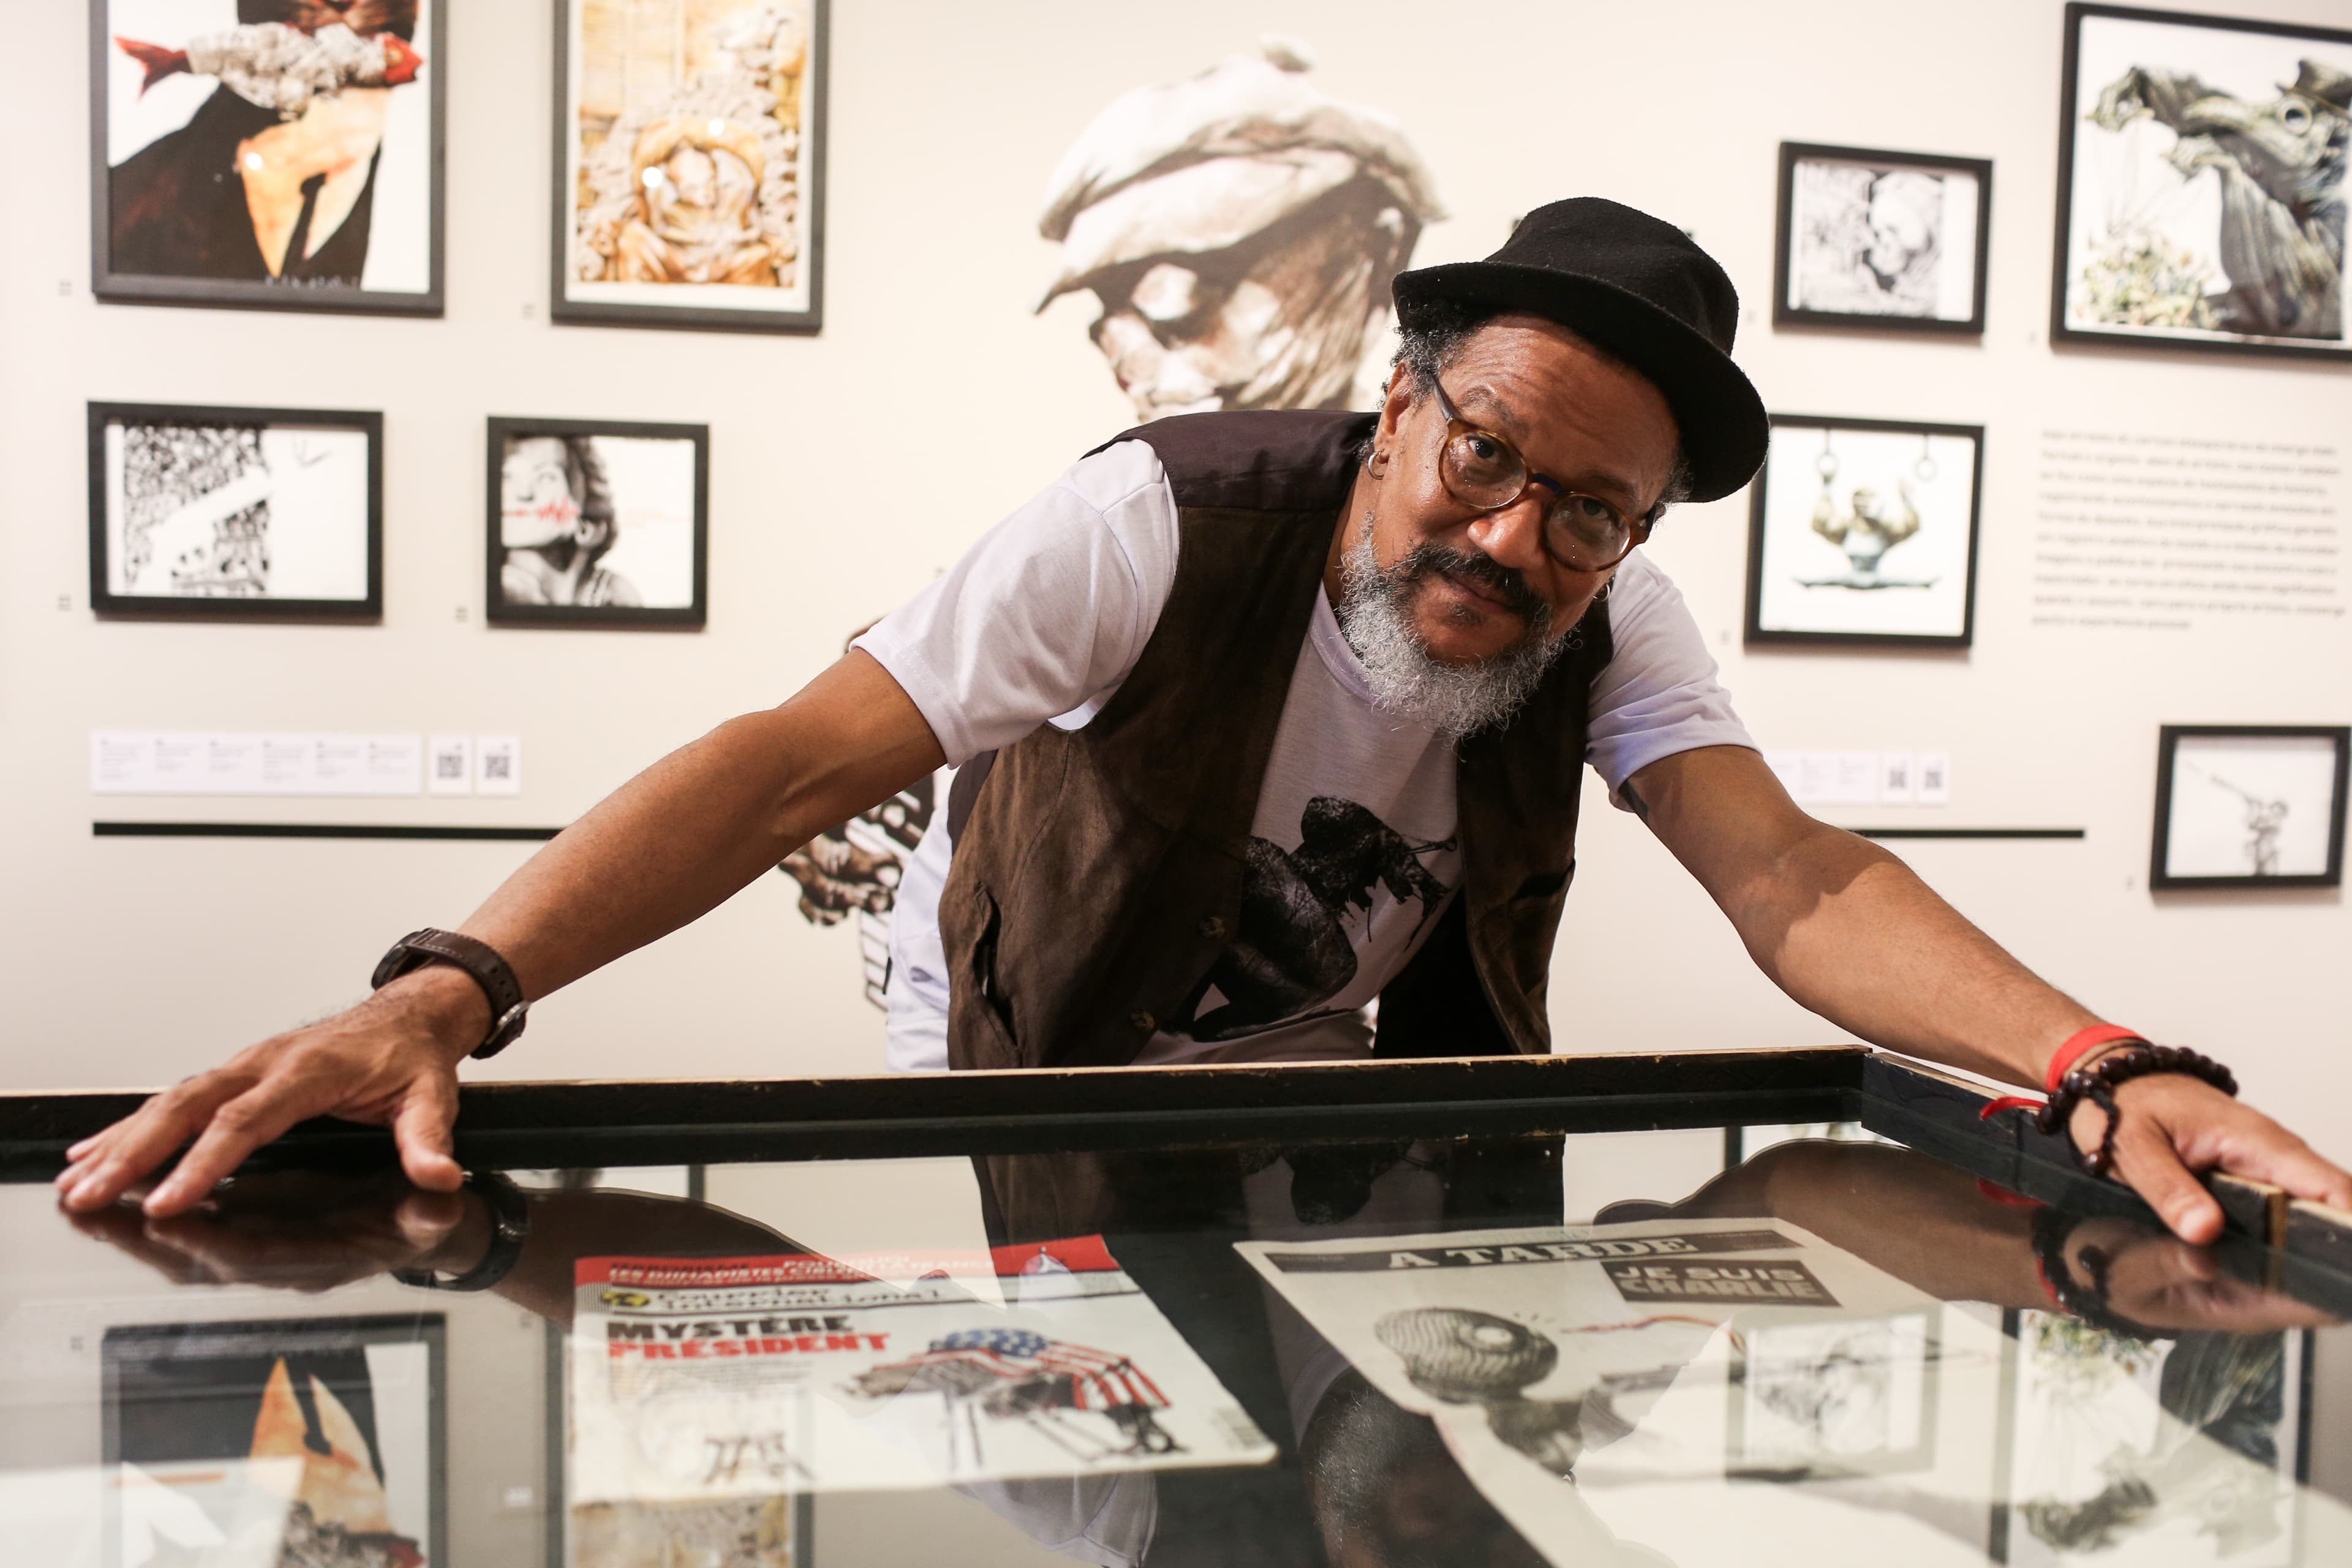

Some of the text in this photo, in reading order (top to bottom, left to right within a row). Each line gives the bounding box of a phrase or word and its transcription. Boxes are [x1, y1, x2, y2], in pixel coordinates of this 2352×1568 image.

[1389, 1237, 1698, 1269] A TARDE
[609, 1268, 643, 1279] LES
[1613, 1266, 1804, 1281] JE SUIS
[1619, 1279, 1823, 1298] CHARLIE
